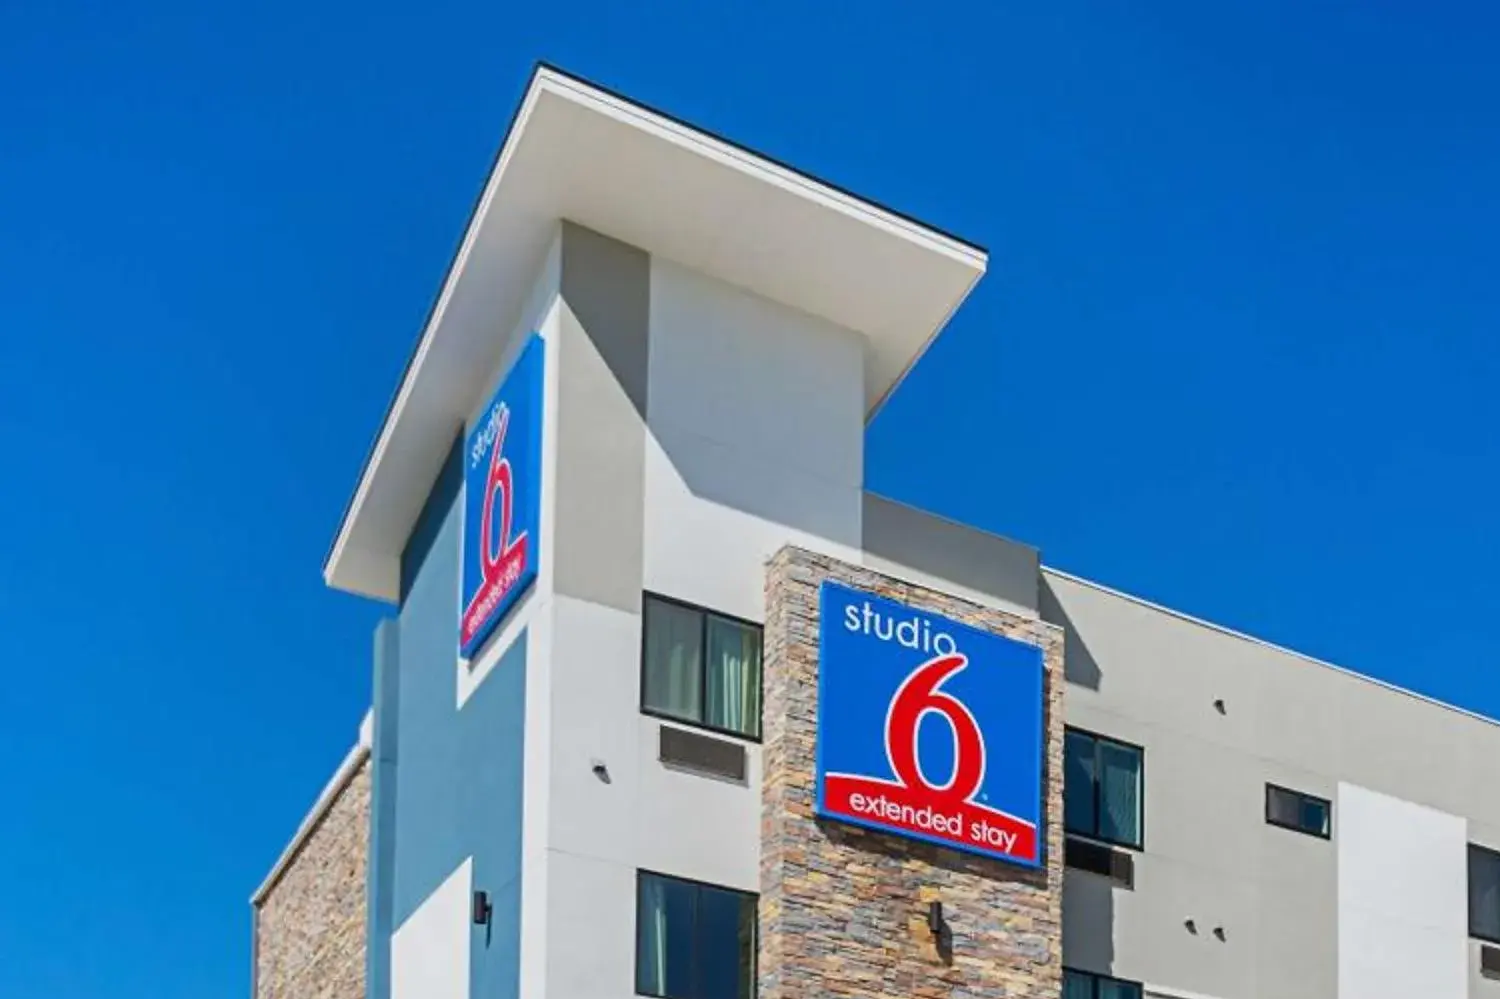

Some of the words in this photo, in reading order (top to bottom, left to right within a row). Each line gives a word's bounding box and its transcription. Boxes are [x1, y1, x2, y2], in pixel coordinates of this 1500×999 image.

[844, 601, 957, 657] studio
[884, 652, 987, 803] 6
[848, 790, 964, 837] extended
[970, 819, 1018, 855] stay
